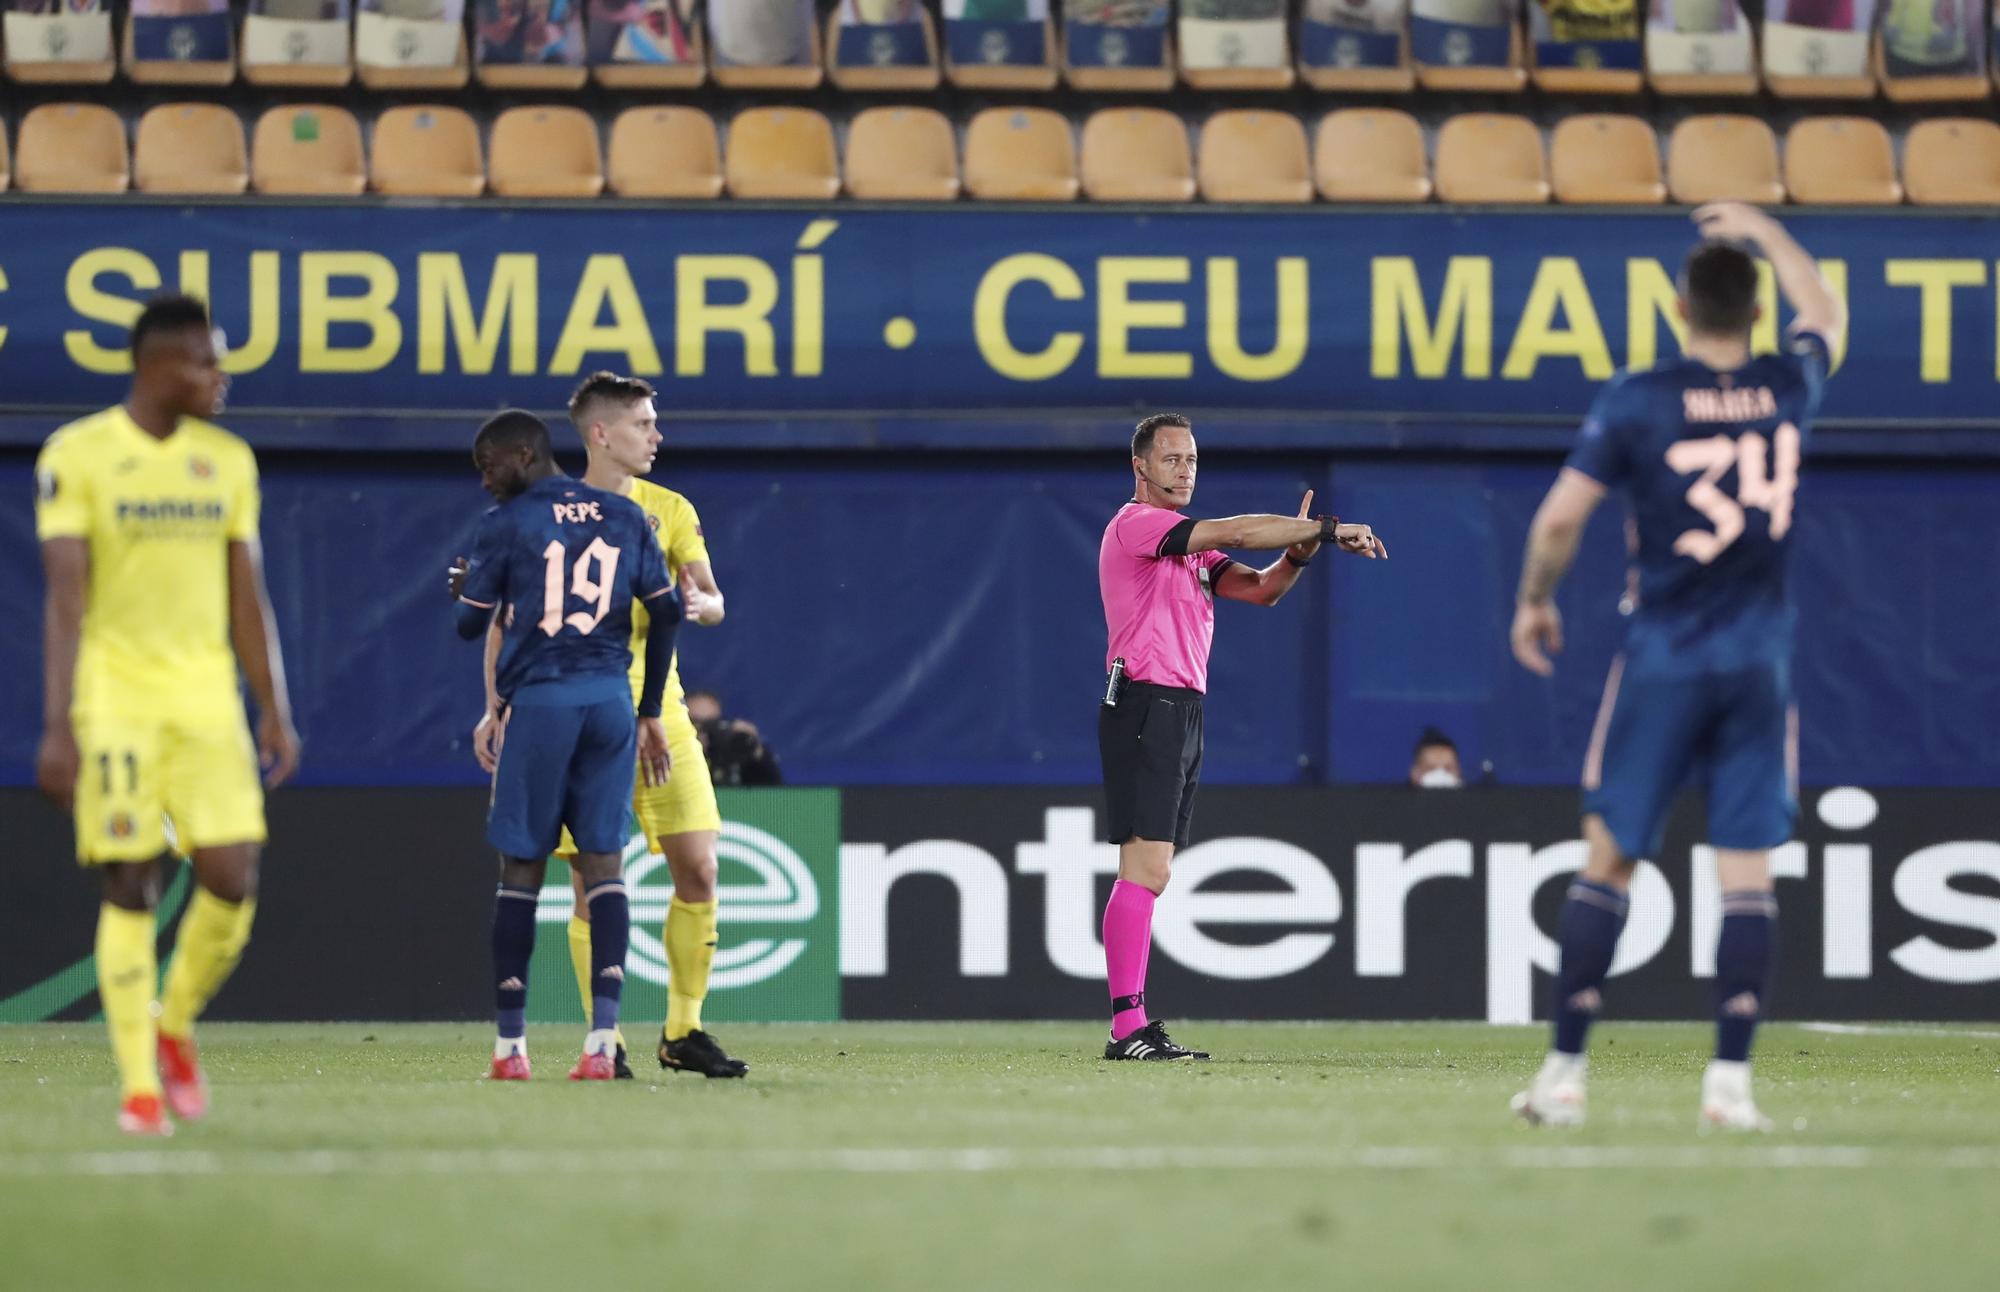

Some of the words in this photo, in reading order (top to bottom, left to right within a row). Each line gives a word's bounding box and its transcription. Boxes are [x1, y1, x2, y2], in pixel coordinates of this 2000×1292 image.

[63, 219, 838, 378] SUBMARÍ
[972, 252, 1311, 382] CEU
[1885, 258, 2000, 383] T
[1664, 420, 1800, 565] 34
[537, 536, 621, 638] 19
[96, 750, 138, 796] 11
